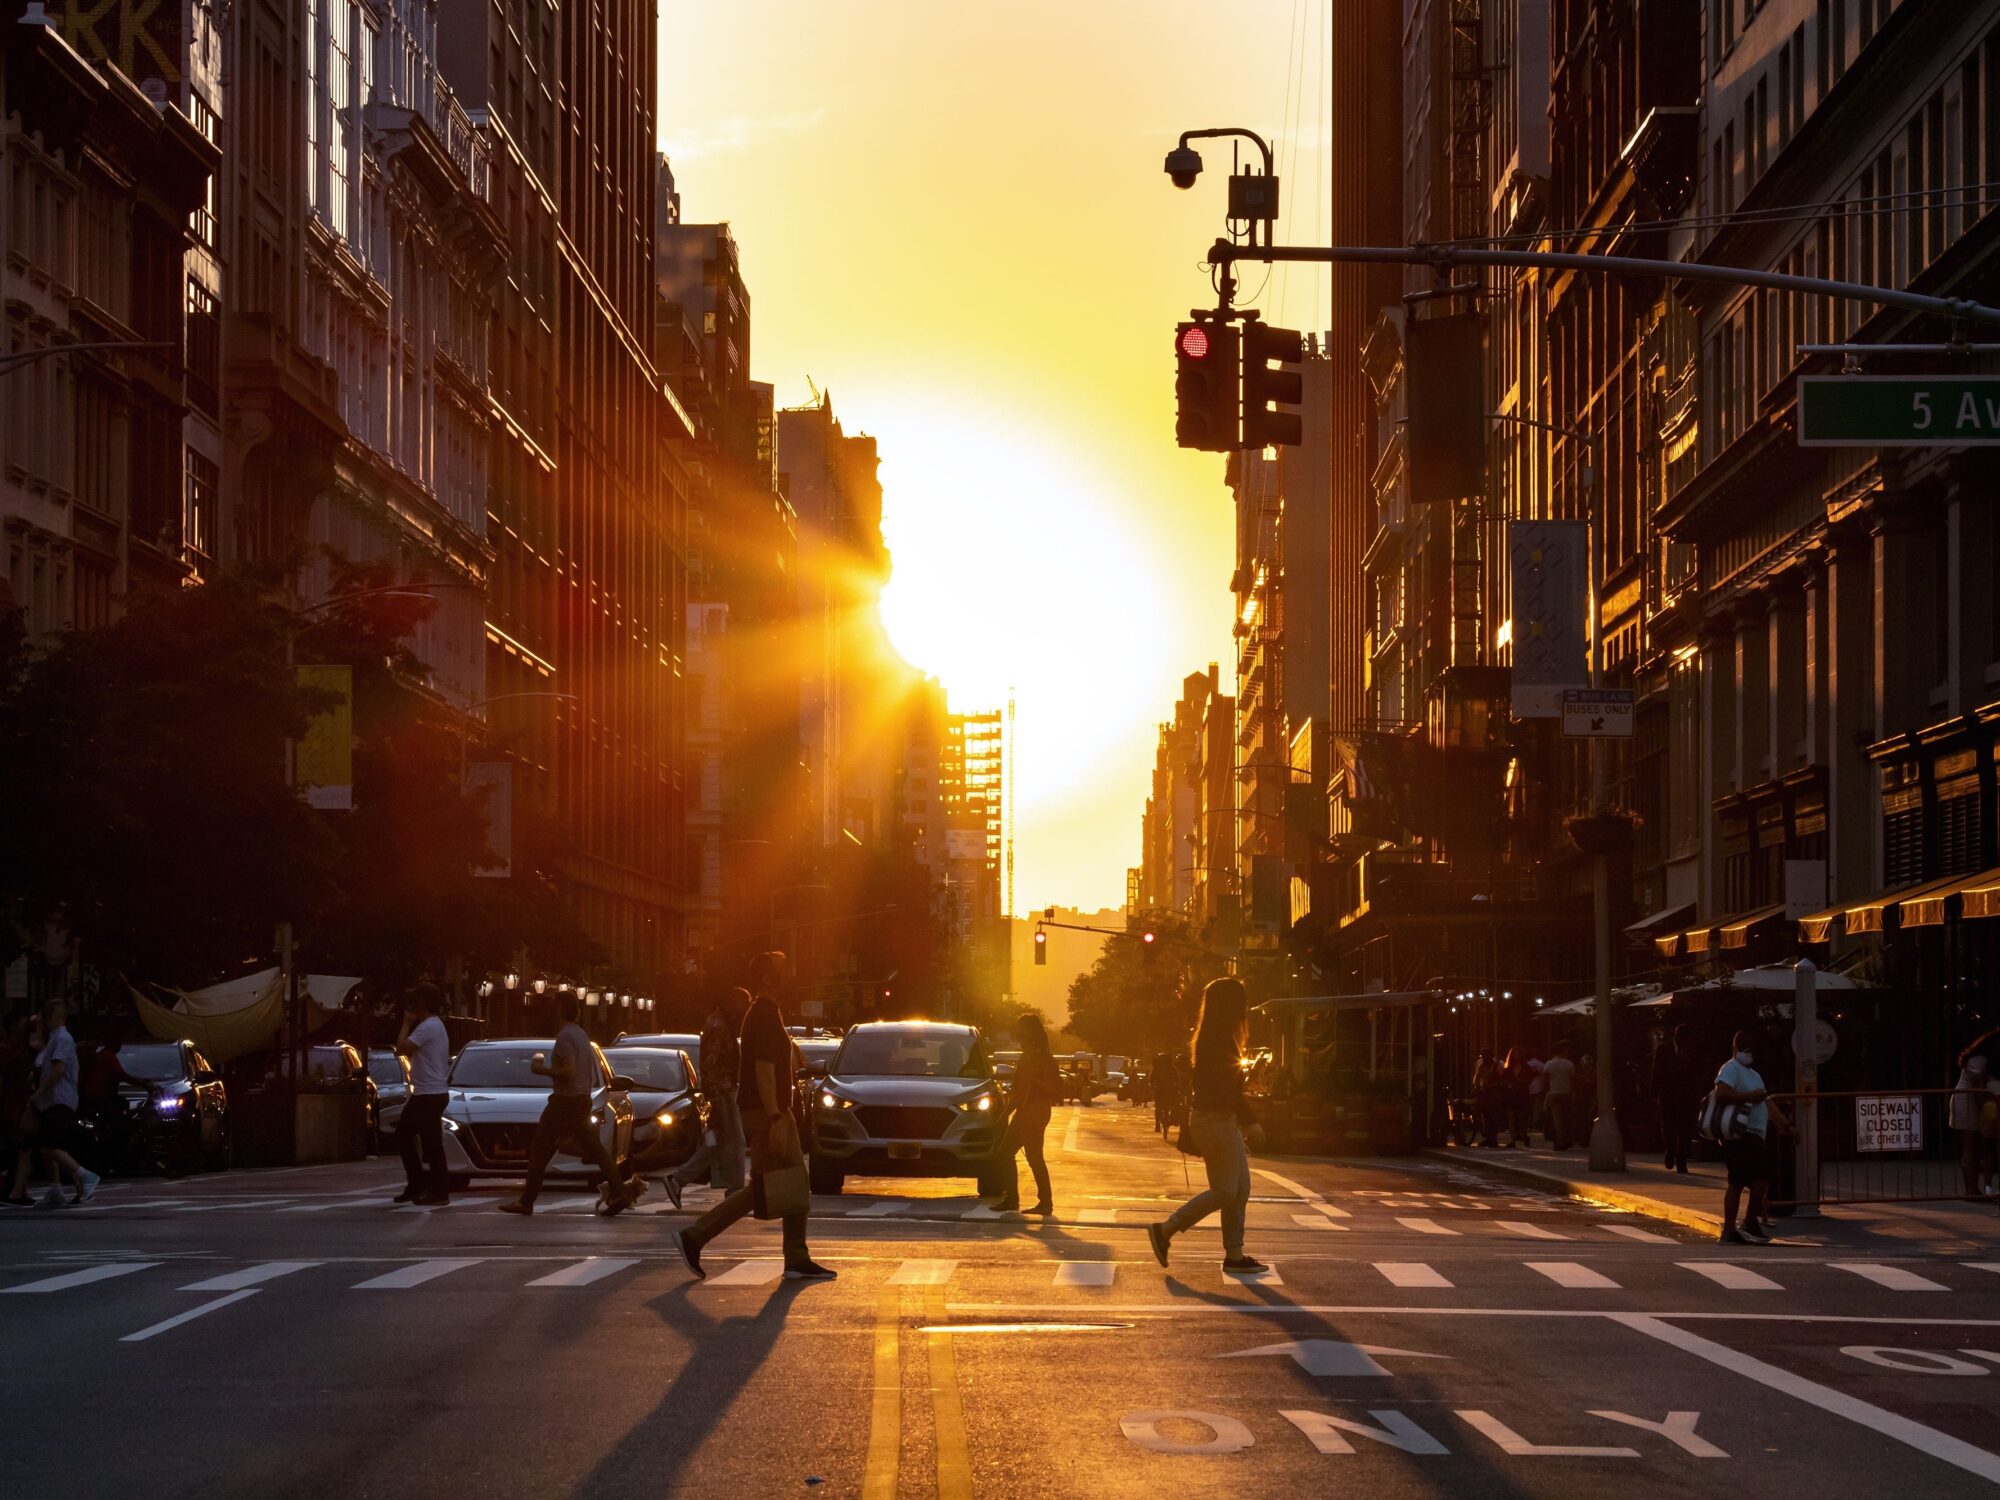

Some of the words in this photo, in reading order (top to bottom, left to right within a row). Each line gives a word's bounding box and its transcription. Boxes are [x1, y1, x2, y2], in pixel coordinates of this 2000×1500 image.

[1912, 391, 1932, 430] 5
[1566, 703, 1600, 714] BUSES
[1604, 704, 1631, 715] ONLY
[1860, 1102, 1919, 1117] SIDEWALK
[1866, 1118, 1913, 1132] CLOSED
[1860, 1135, 1874, 1145] USE
[1877, 1134, 1901, 1145] OTHER
[1117, 1408, 1732, 1458] ONLY
